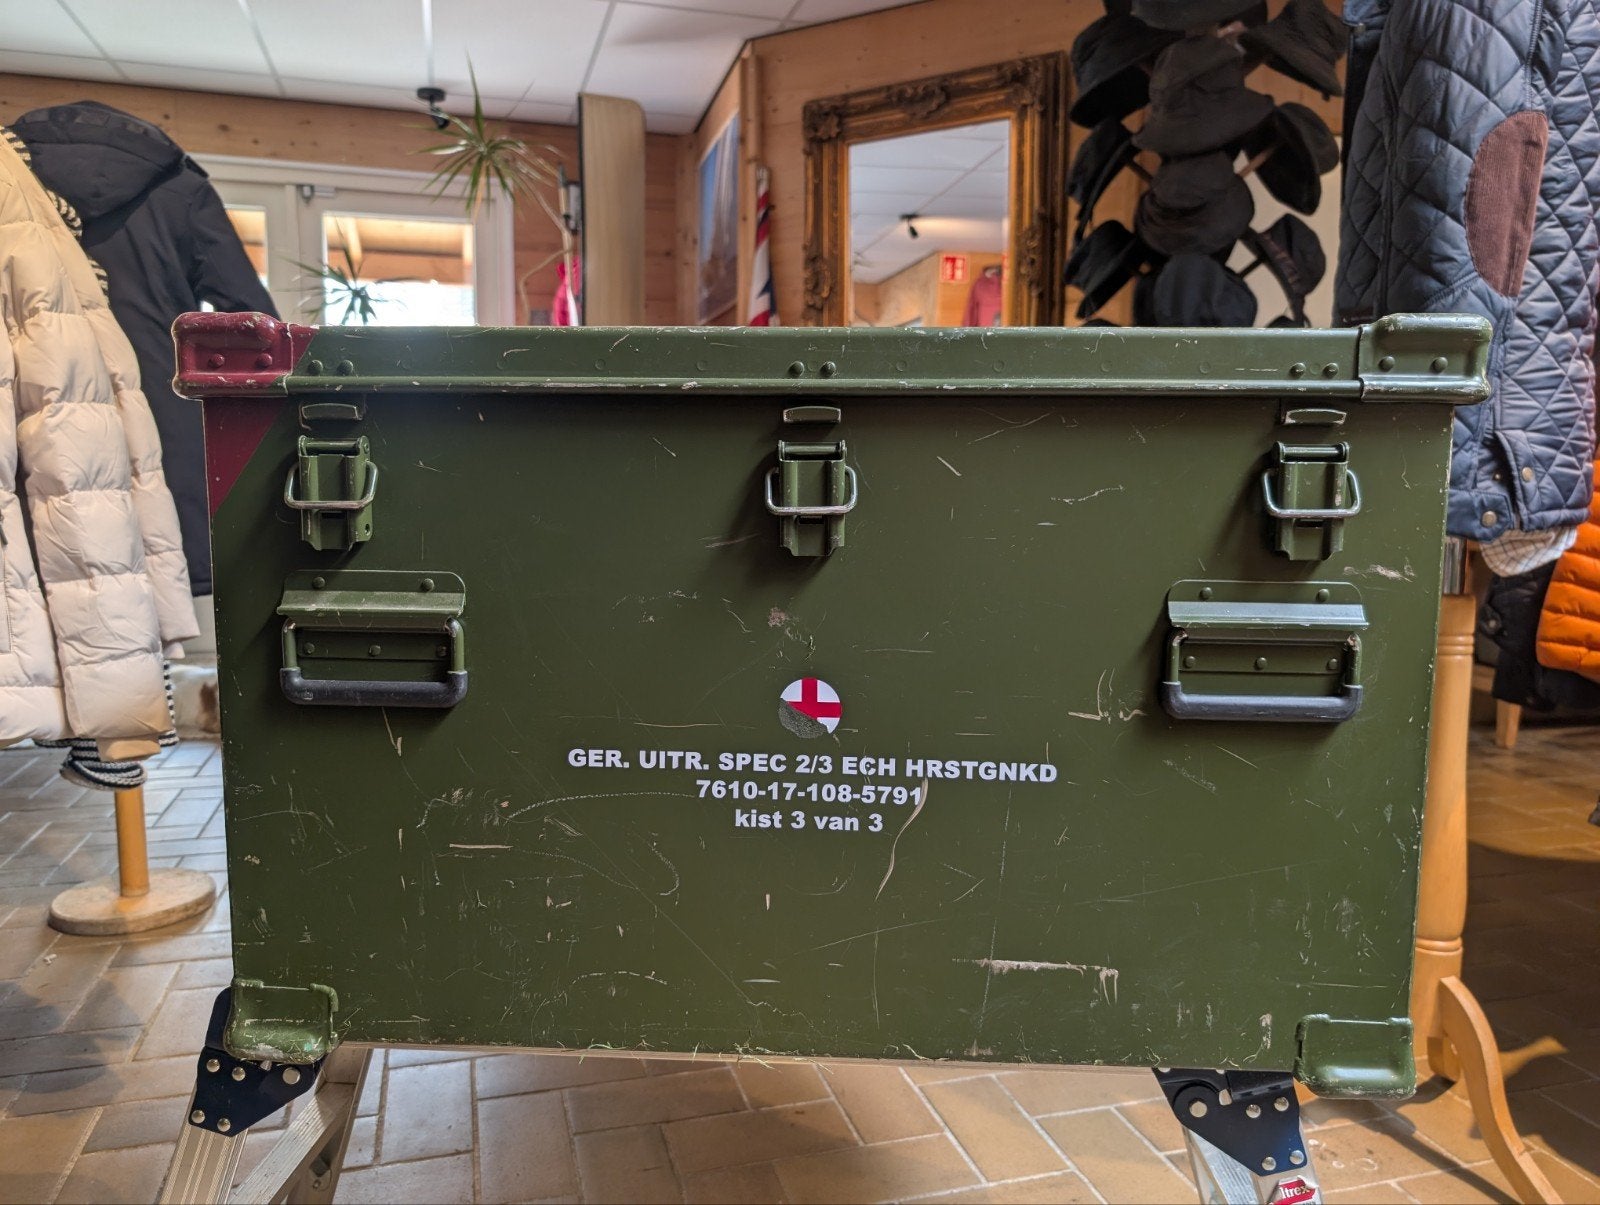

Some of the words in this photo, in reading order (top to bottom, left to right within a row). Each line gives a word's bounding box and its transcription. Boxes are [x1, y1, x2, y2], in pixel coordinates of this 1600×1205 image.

[568, 748, 630, 769] GER.
[639, 750, 710, 771] UITR.
[718, 752, 787, 773] SPEC
[795, 754, 833, 774] 2/3
[842, 756, 896, 777] ECH
[905, 758, 1058, 783] HRSTGNKD
[696, 779, 922, 806] 7610-17-108-5791
[735, 808, 783, 829] kist
[790, 810, 806, 829] 3
[813, 815, 859, 832] van
[868, 813, 884, 832] 3
